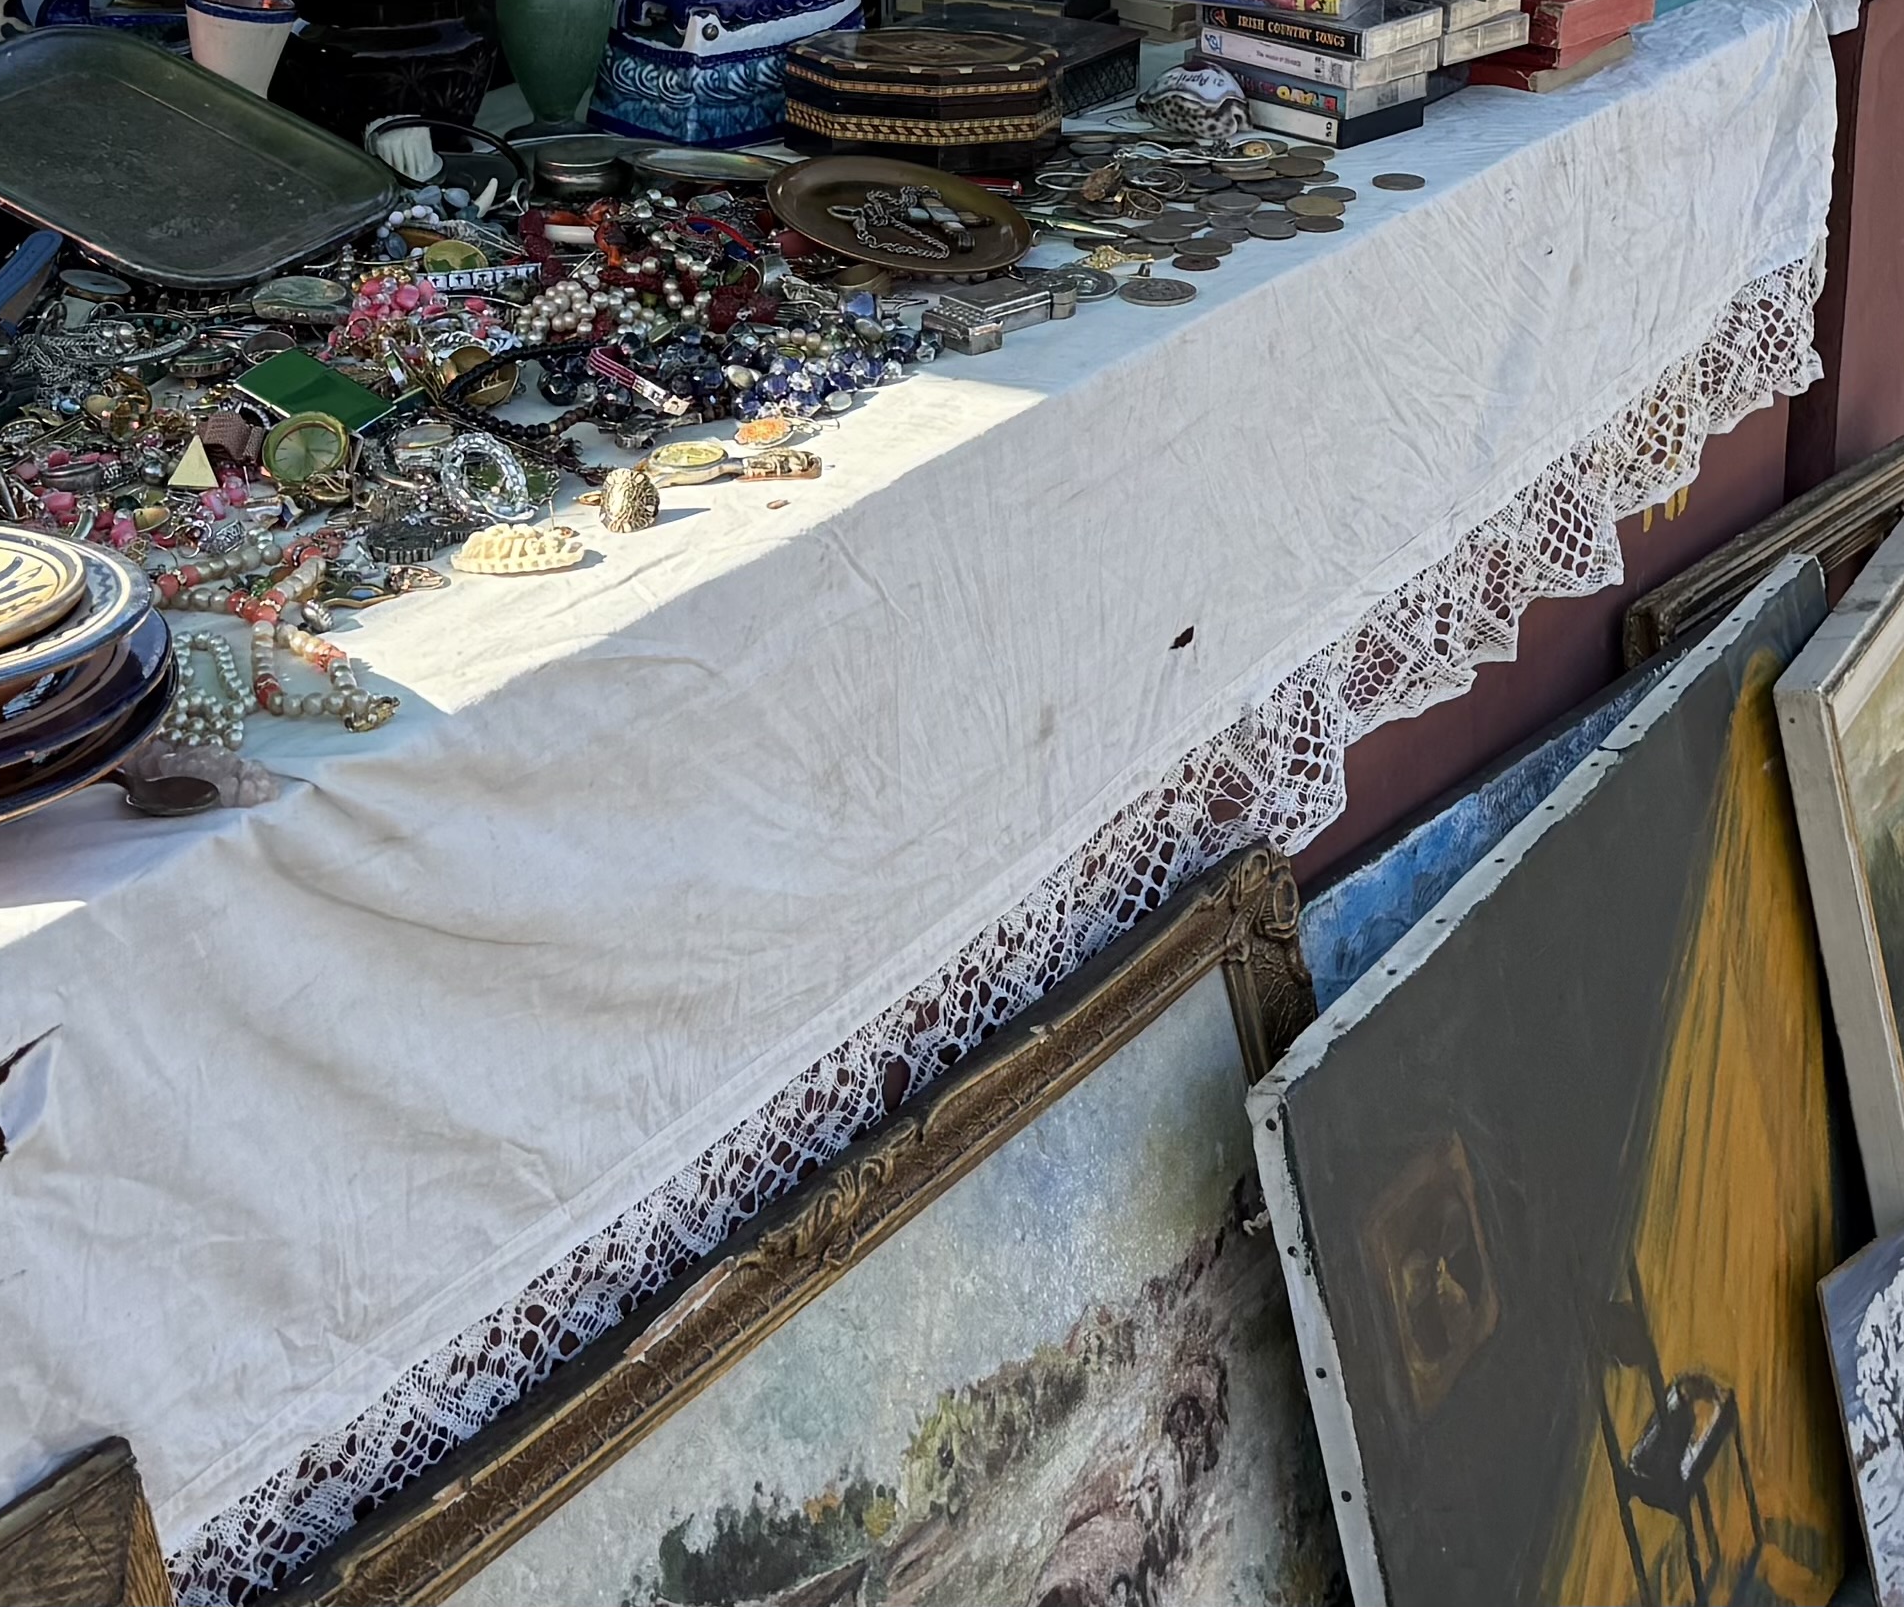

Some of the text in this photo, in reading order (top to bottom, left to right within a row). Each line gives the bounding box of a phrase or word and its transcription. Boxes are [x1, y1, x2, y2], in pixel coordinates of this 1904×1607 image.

[1237, 14, 1346, 48] IRISH COUNTRY SONGS
